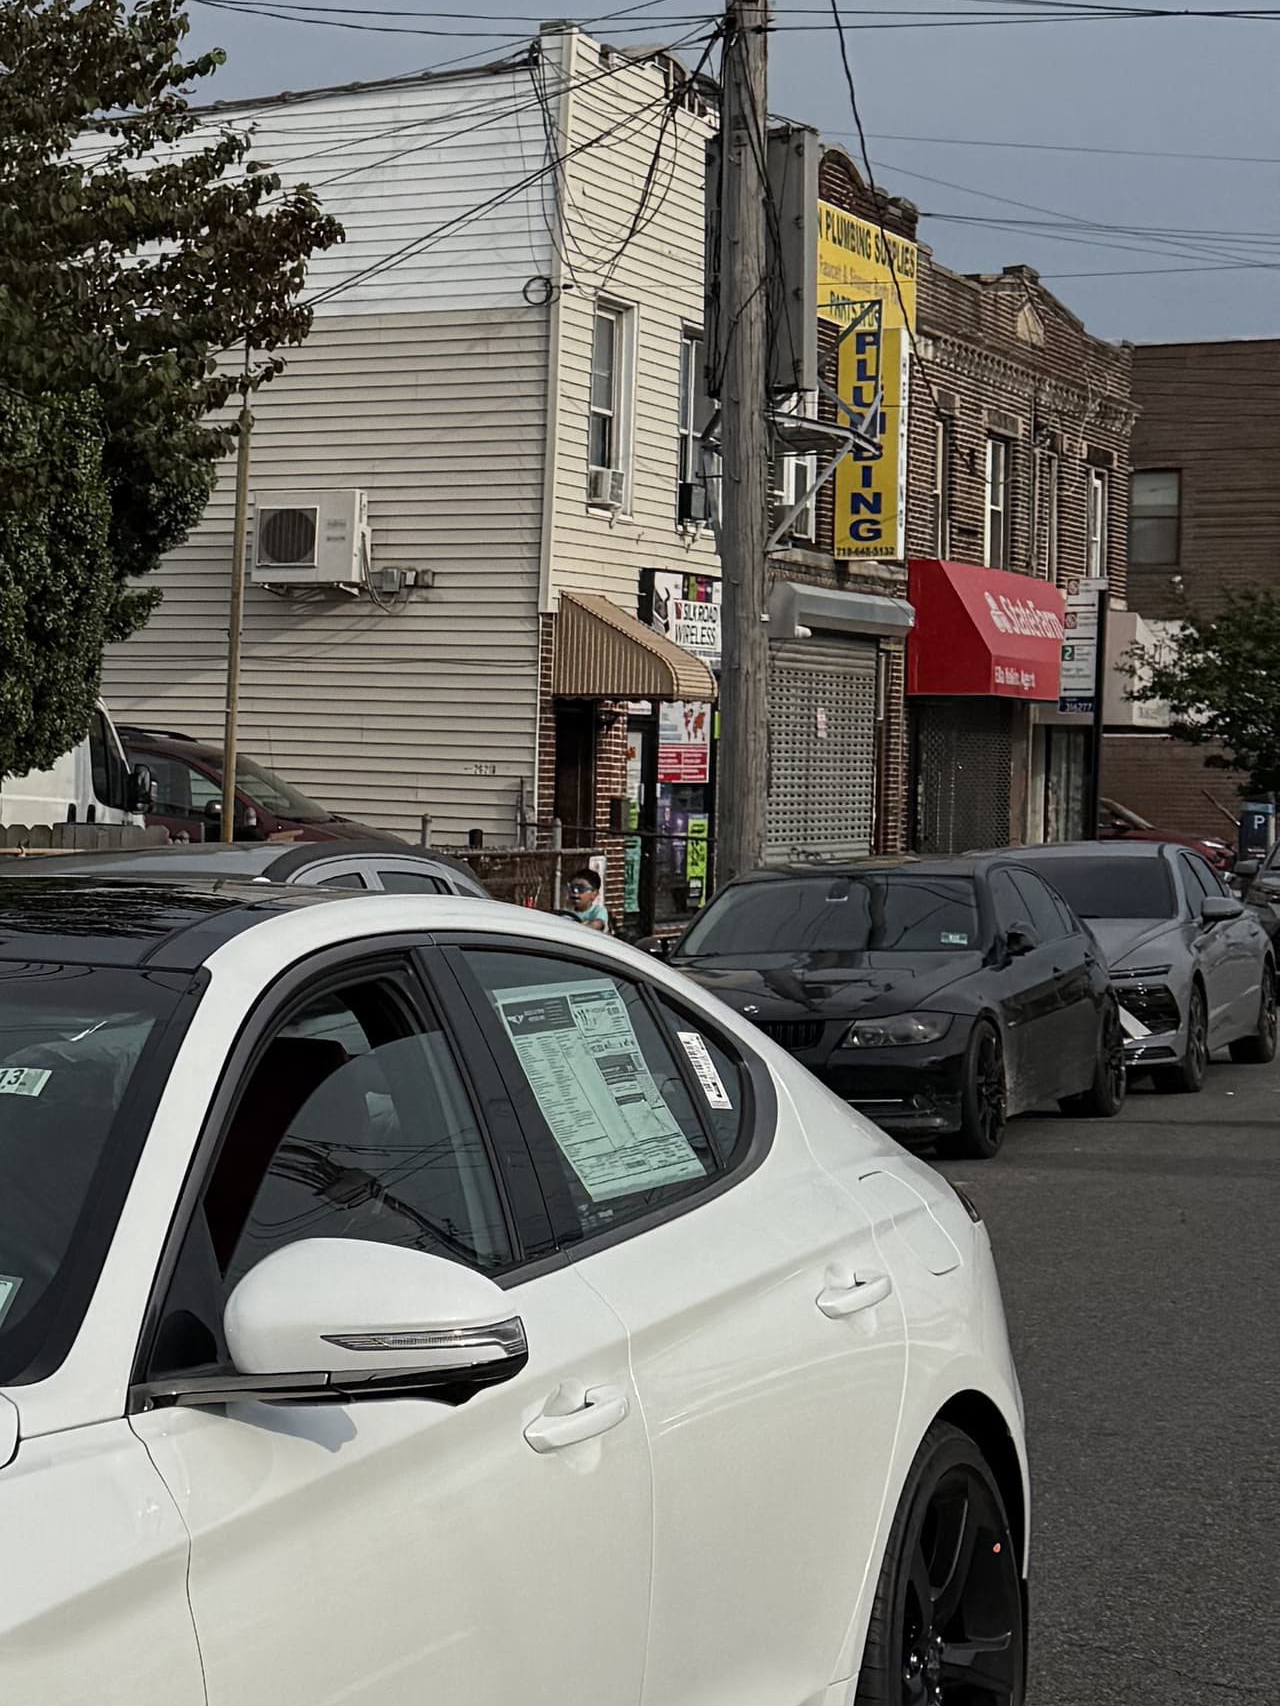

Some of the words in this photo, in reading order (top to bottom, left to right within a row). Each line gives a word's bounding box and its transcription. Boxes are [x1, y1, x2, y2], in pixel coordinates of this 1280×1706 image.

[826, 210, 871, 261] PLUMBING
[849, 332, 885, 541] PLUMBING
[675, 623, 716, 646] WIRELESS
[1254, 815, 1265, 829] P
